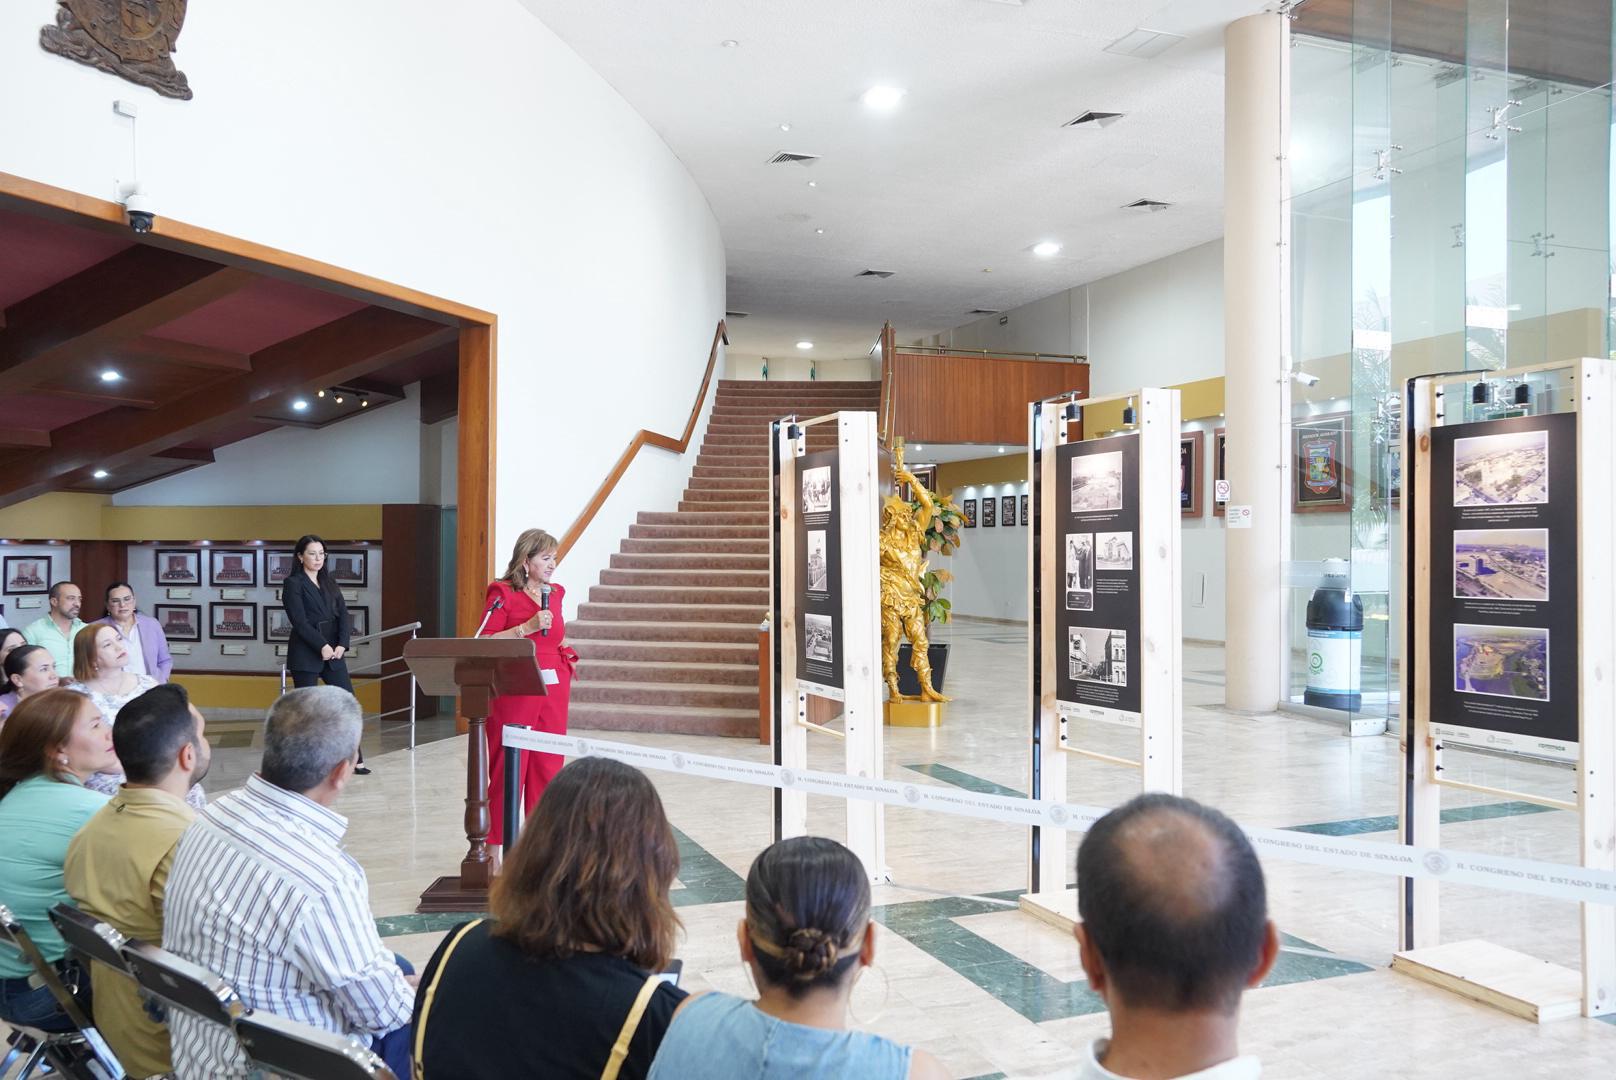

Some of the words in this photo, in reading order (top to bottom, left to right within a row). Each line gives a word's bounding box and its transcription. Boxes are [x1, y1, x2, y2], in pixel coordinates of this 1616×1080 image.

[1257, 838, 1302, 849] CONGRESO
[1304, 844, 1321, 852] DEL
[1323, 847, 1357, 857] ESTADO
[1373, 853, 1413, 863] SINALOA
[1470, 864, 1524, 878] CONGRESO
[1527, 872, 1546, 881] DEL
[1550, 876, 1592, 888] ESTADO
[1594, 882, 1610, 891] DE
